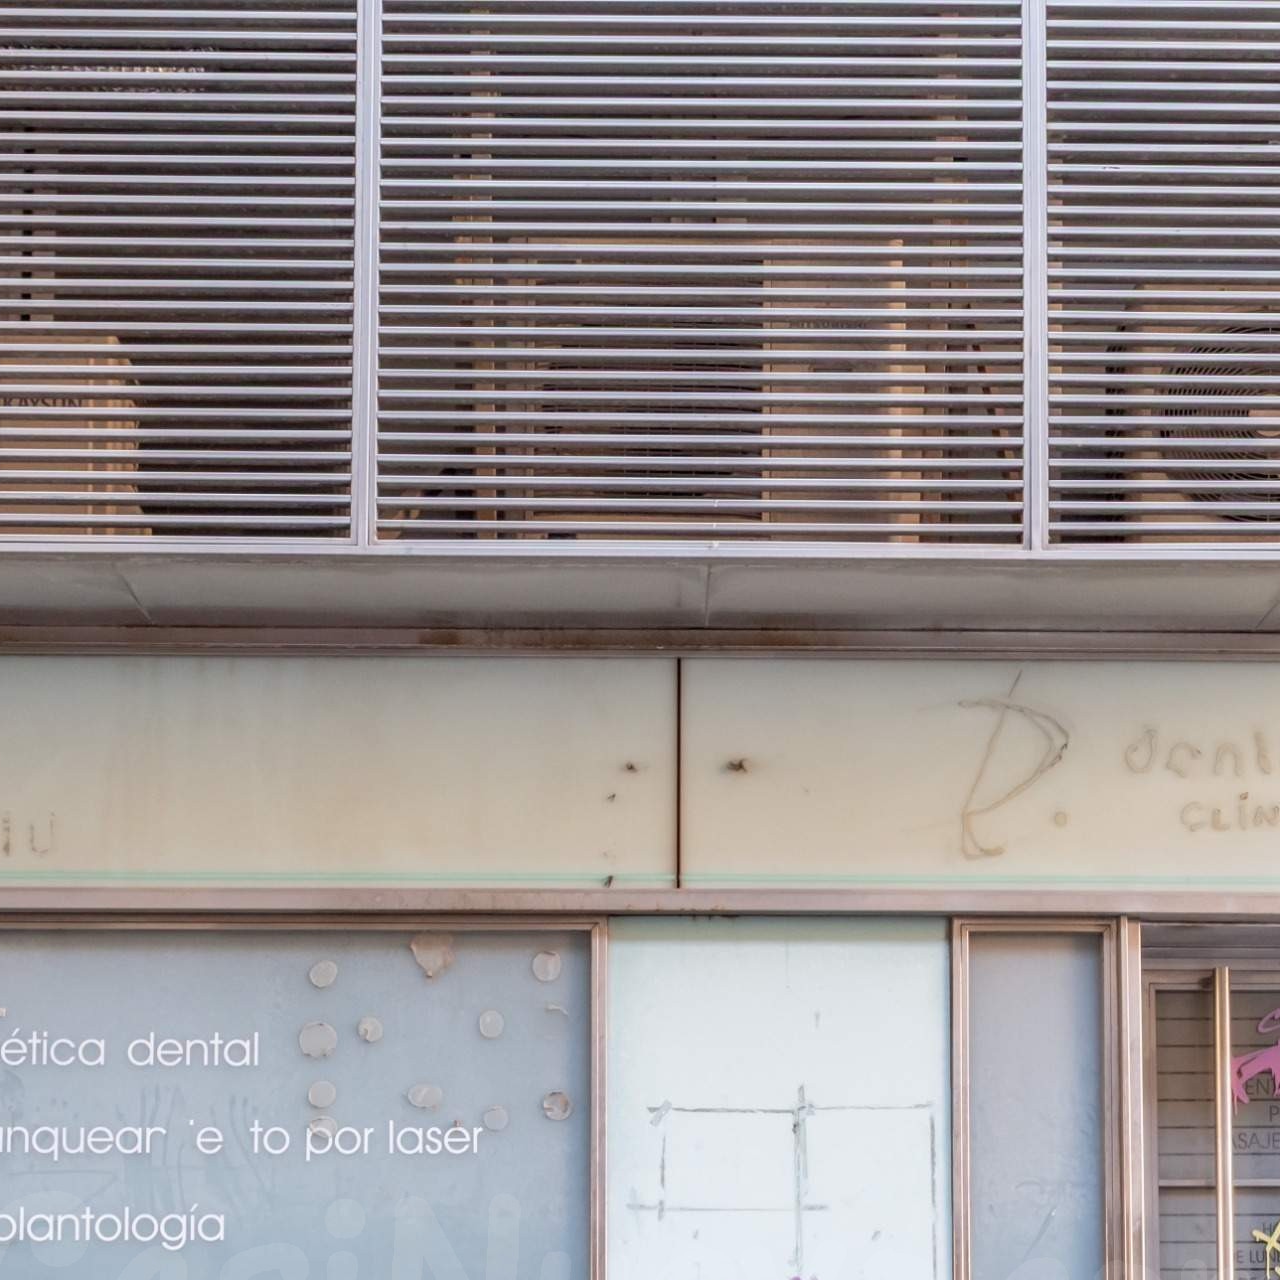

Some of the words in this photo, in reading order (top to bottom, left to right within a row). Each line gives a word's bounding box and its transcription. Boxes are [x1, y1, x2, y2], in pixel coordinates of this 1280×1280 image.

[126, 1031, 260, 1067] dental
[306, 1123, 374, 1162] por
[388, 1119, 483, 1155] laser
